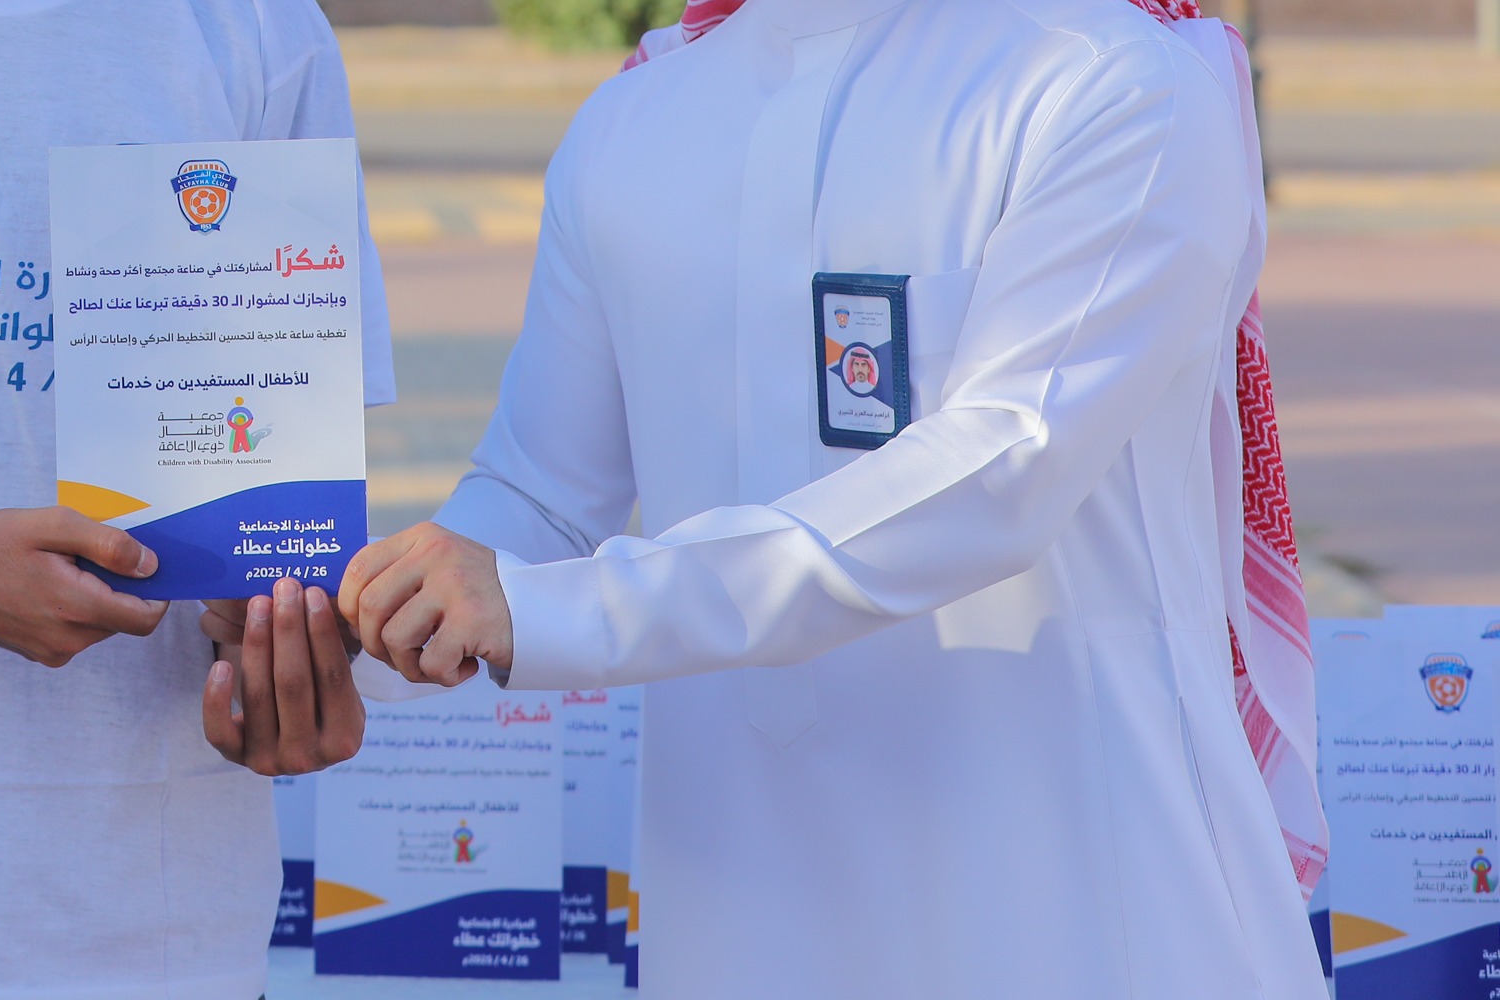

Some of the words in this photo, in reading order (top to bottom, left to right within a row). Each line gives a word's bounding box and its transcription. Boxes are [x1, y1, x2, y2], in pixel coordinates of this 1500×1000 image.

[180, 179, 209, 190] ALFAYHA
[212, 180, 229, 189] CLUB
[65, 265, 97, 278] ونشاط
[99, 266, 121, 276] صحة
[123, 264, 142, 278] أكثر
[144, 266, 175, 277] مجتمع
[177, 264, 205, 275] صناعة
[207, 262, 222, 278] في
[224, 261, 272, 275] لمشاركتك
[69, 298, 103, 314] لصالح
[106, 297, 132, 310] عنك
[135, 296, 168, 312] تبرعنا
[171, 294, 208, 311] دقيقة
[212, 295, 229, 307] 30
[246, 292, 289, 309] لمشوار
[293, 291, 347, 308] وبإنجازك
[70, 333, 97, 347] الرأس
[99, 334, 137, 347] وإصابات
[139, 332, 174, 349] الحركي
[176, 332, 216, 344] التخطيط
[218, 331, 255, 344] لتحسين
[257, 330, 287, 343] علاجية
[289, 329, 314, 340] ساعة
[316, 328, 347, 341] تغطية
[7, 362, 27, 392] 4
[107, 376, 152, 390] خدمات
[178, 374, 255, 391] المستفيدين
[258, 371, 309, 389] للأطفال
[155, 378, 175, 391] من
[157, 459, 186, 467] Children
[187, 458, 202, 466] with
[203, 458, 234, 467] Disability
[235, 457, 272, 466] Association
[238, 520, 292, 535] الاجتماعية
[293, 519, 335, 533] المبادرة
[232, 539, 273, 556] عطاء
[276, 537, 342, 558] خطواتك
[293, 566, 302, 577] 4
[312, 566, 328, 577] 26
